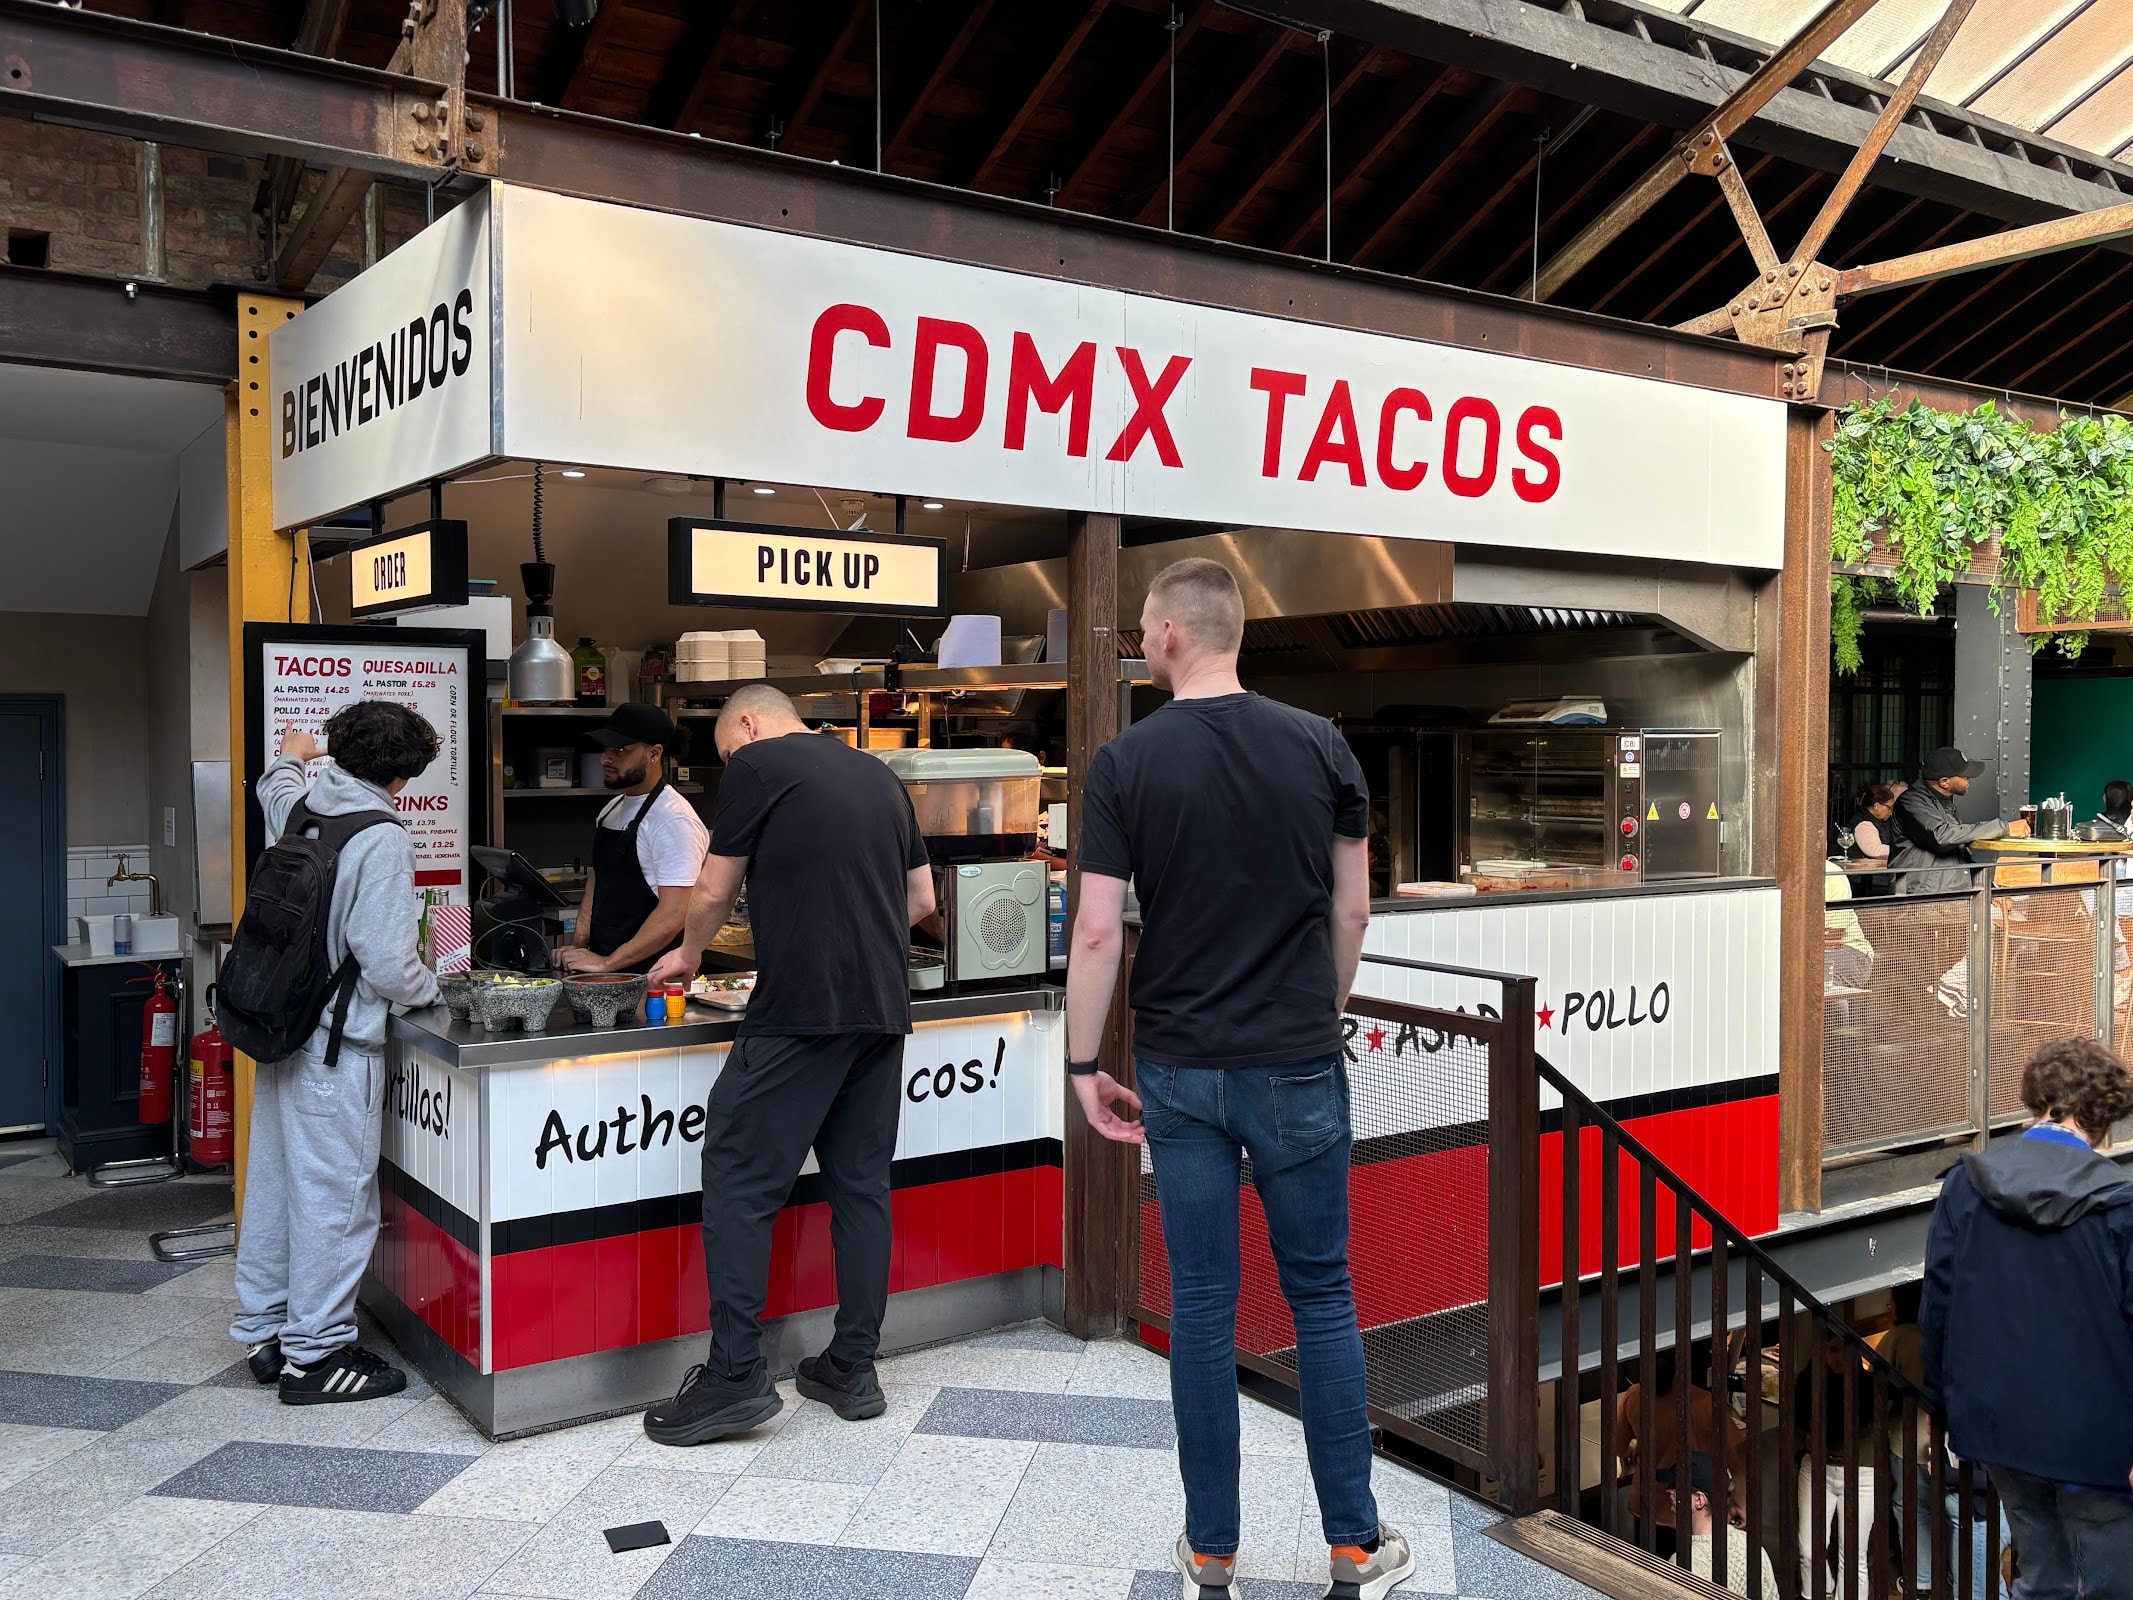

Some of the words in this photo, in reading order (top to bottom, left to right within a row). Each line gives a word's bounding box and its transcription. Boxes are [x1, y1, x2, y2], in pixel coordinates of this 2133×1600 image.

[282, 288, 473, 460] BIENVENIDOS
[807, 303, 1193, 469] CDMX
[1250, 367, 1564, 503] TACOS
[374, 551, 406, 592] ORDER
[758, 545, 833, 587] PICK
[843, 552, 879, 590] UP
[274, 656, 352, 677] TACOS
[362, 660, 458, 675] QUESADILLA
[273, 685, 285, 693] AL
[287, 685, 320, 694] PASTOR
[324, 686, 350, 694] £4.25
[362, 679, 374, 687] AL
[376, 680, 407, 688] PASTOR
[411, 680, 436, 688] £5.25
[273, 695, 309, 703] (MARINATED
[449, 684, 457, 706] CORN
[273, 706, 301, 715] POLLO
[304, 707, 330, 715] £4.25
[450, 707, 457, 719] OR
[450, 746, 459, 787] TORTILLA?
[393, 795, 449, 812] RINKS
[412, 841, 427, 849] SCA
[432, 841, 455, 849] £3.25
[1561, 981, 1670, 1036] POLLO
[535, 1094, 705, 1170] Authe
[906, 1036, 1006, 1103] cos!
